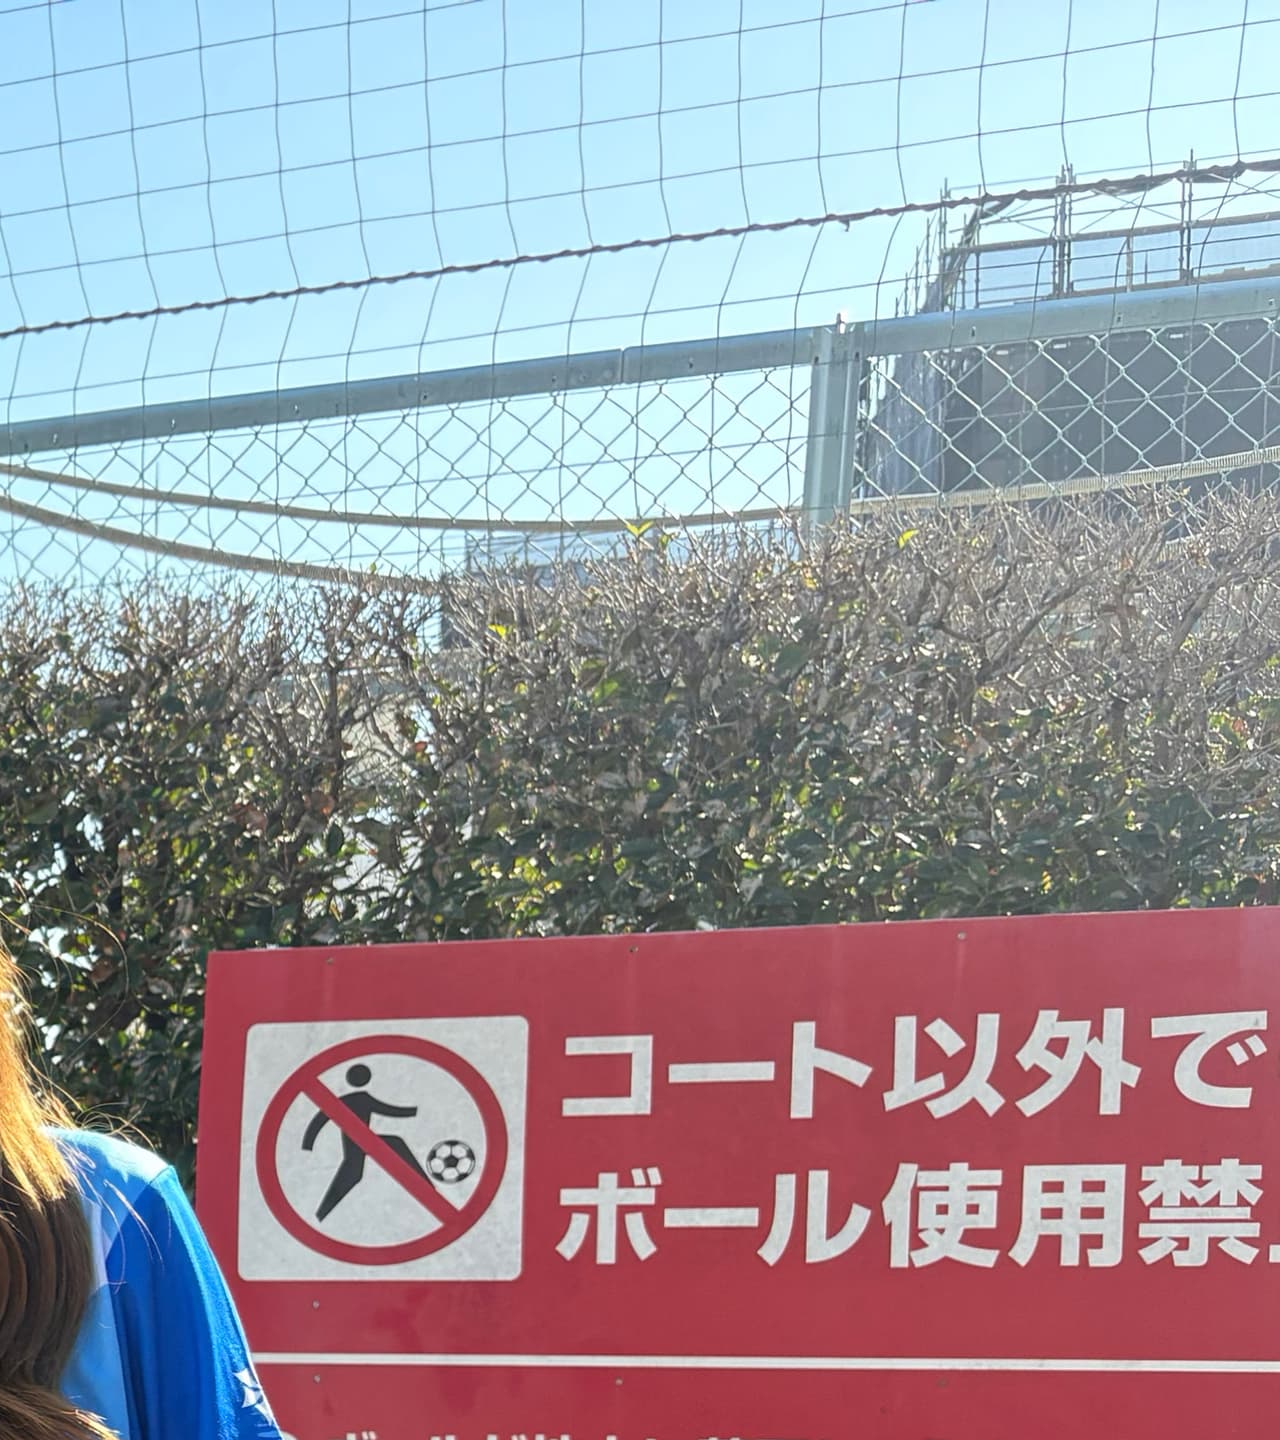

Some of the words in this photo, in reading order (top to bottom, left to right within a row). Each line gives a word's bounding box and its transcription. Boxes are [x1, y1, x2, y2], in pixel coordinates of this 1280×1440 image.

[562, 1006, 1268, 1117] コート以外で
[555, 1157, 1280, 1268] ボール使用禁
